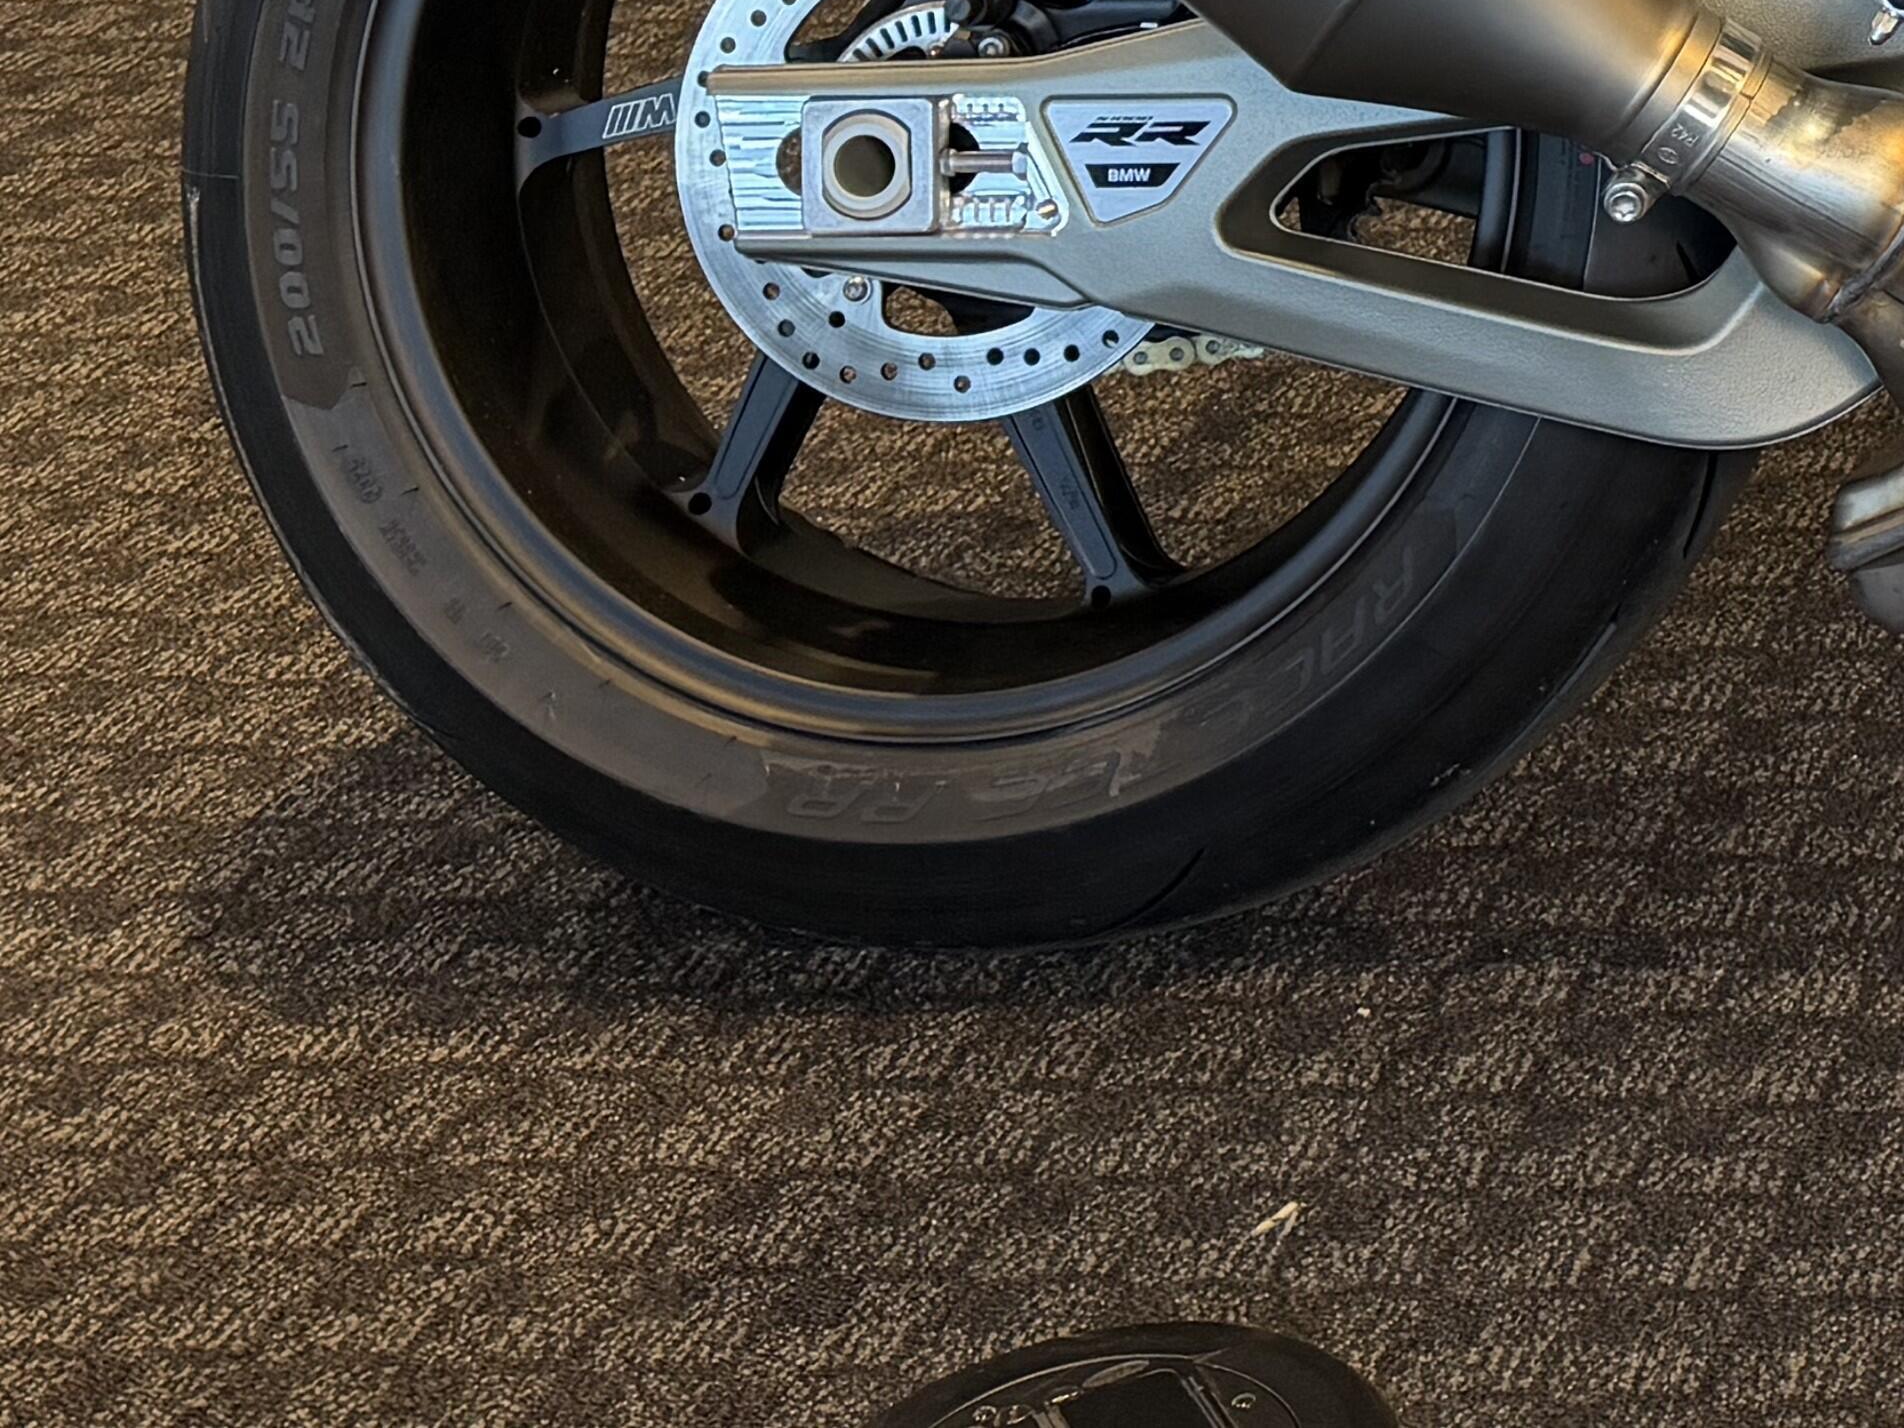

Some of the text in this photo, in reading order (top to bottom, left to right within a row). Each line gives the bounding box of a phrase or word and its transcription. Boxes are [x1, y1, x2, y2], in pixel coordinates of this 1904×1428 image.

[1068, 120, 1213, 147] RR
[1106, 167, 1151, 183] BMW
[270, 96, 325, 358] 200/55
